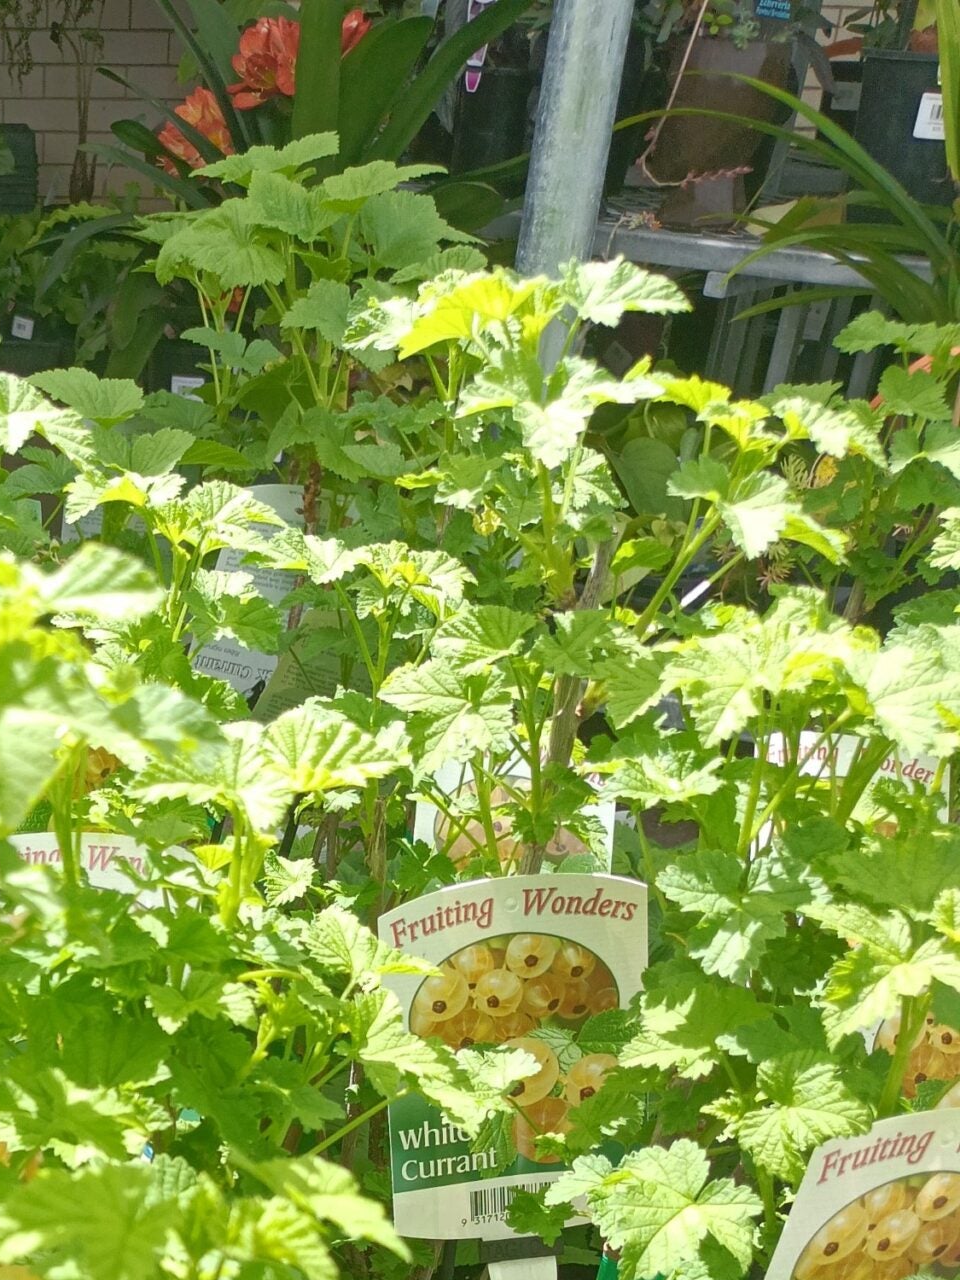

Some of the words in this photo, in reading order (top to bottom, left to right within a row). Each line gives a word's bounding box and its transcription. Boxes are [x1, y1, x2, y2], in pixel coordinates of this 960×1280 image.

[389, 897, 494, 949] Fruiting
[522, 887, 639, 921] Wonders
[401, 1146, 498, 1182] Currant
[816, 1130, 936, 1186] Fruiting
